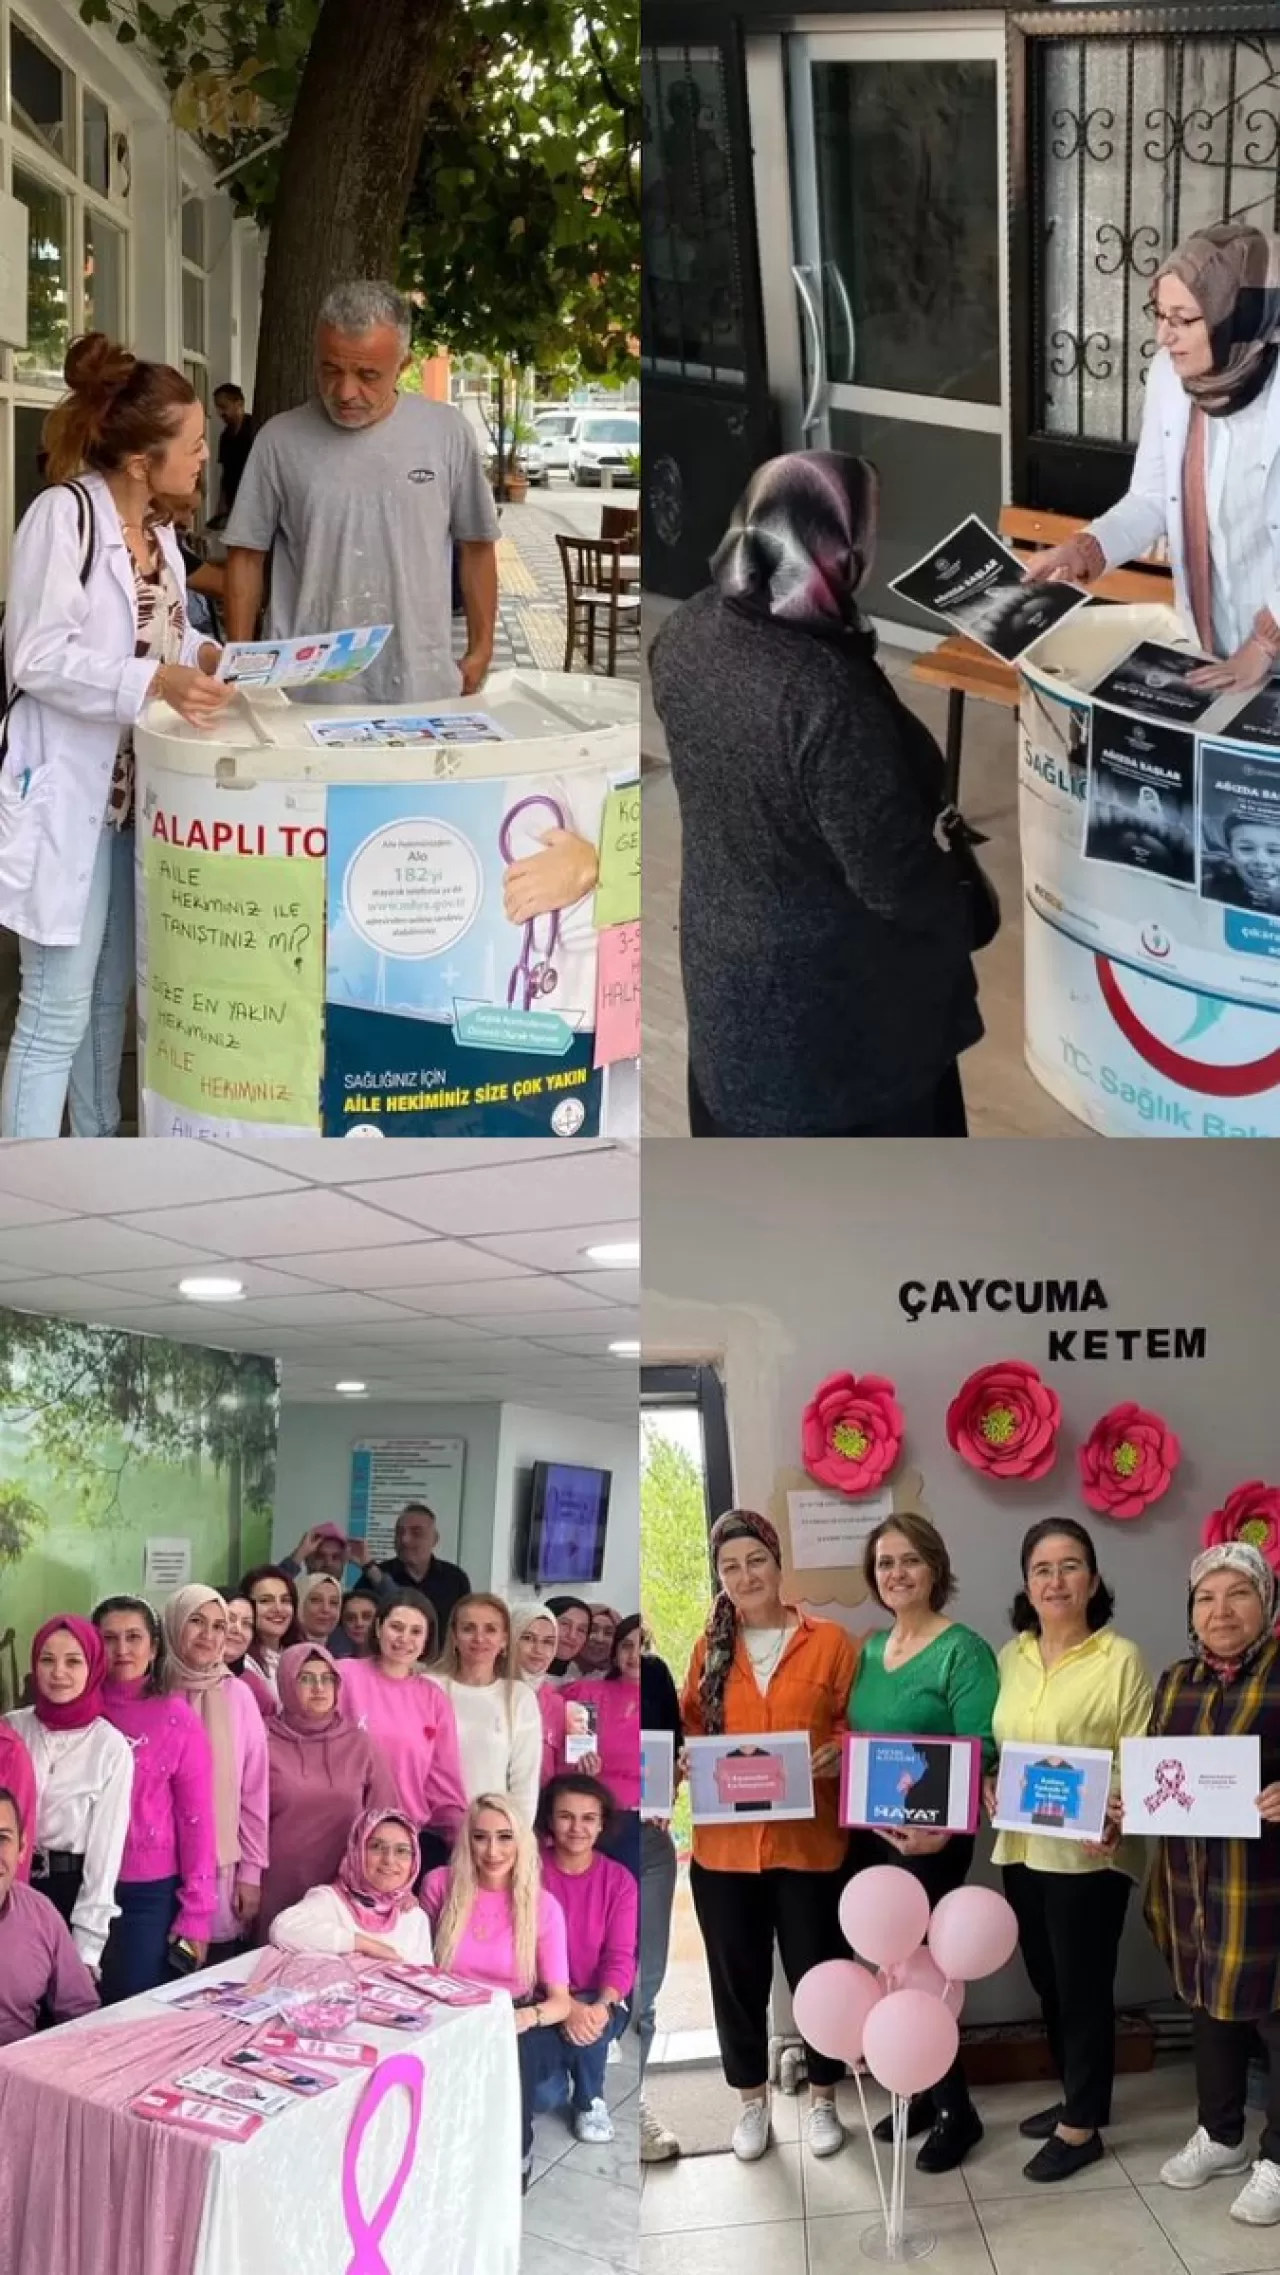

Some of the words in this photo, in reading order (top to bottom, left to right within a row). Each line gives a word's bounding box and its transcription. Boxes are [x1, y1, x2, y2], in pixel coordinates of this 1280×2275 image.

[152, 810, 265, 856] ALAPLI
[278, 825, 328, 858] TO
[407, 850, 428, 861] Alo
[192, 992, 219, 1015] EN
[228, 1001, 287, 1025] YAKIN
[343, 1093, 382, 1113] AİLE
[386, 1087, 470, 1112] HEKİMİNİZ
[474, 1082, 509, 1104] SİZE
[512, 1076, 543, 1102] ÇOK
[545, 1067, 588, 1092] YAKIN
[420, 1067, 447, 1088] İÇİN
[1099, 1065, 1192, 1131] Sağlık
[898, 1278, 1109, 1323] ÇAYCUMA
[1048, 1326, 1207, 1362] KETEM
[873, 1804, 940, 1823] HAYAT
